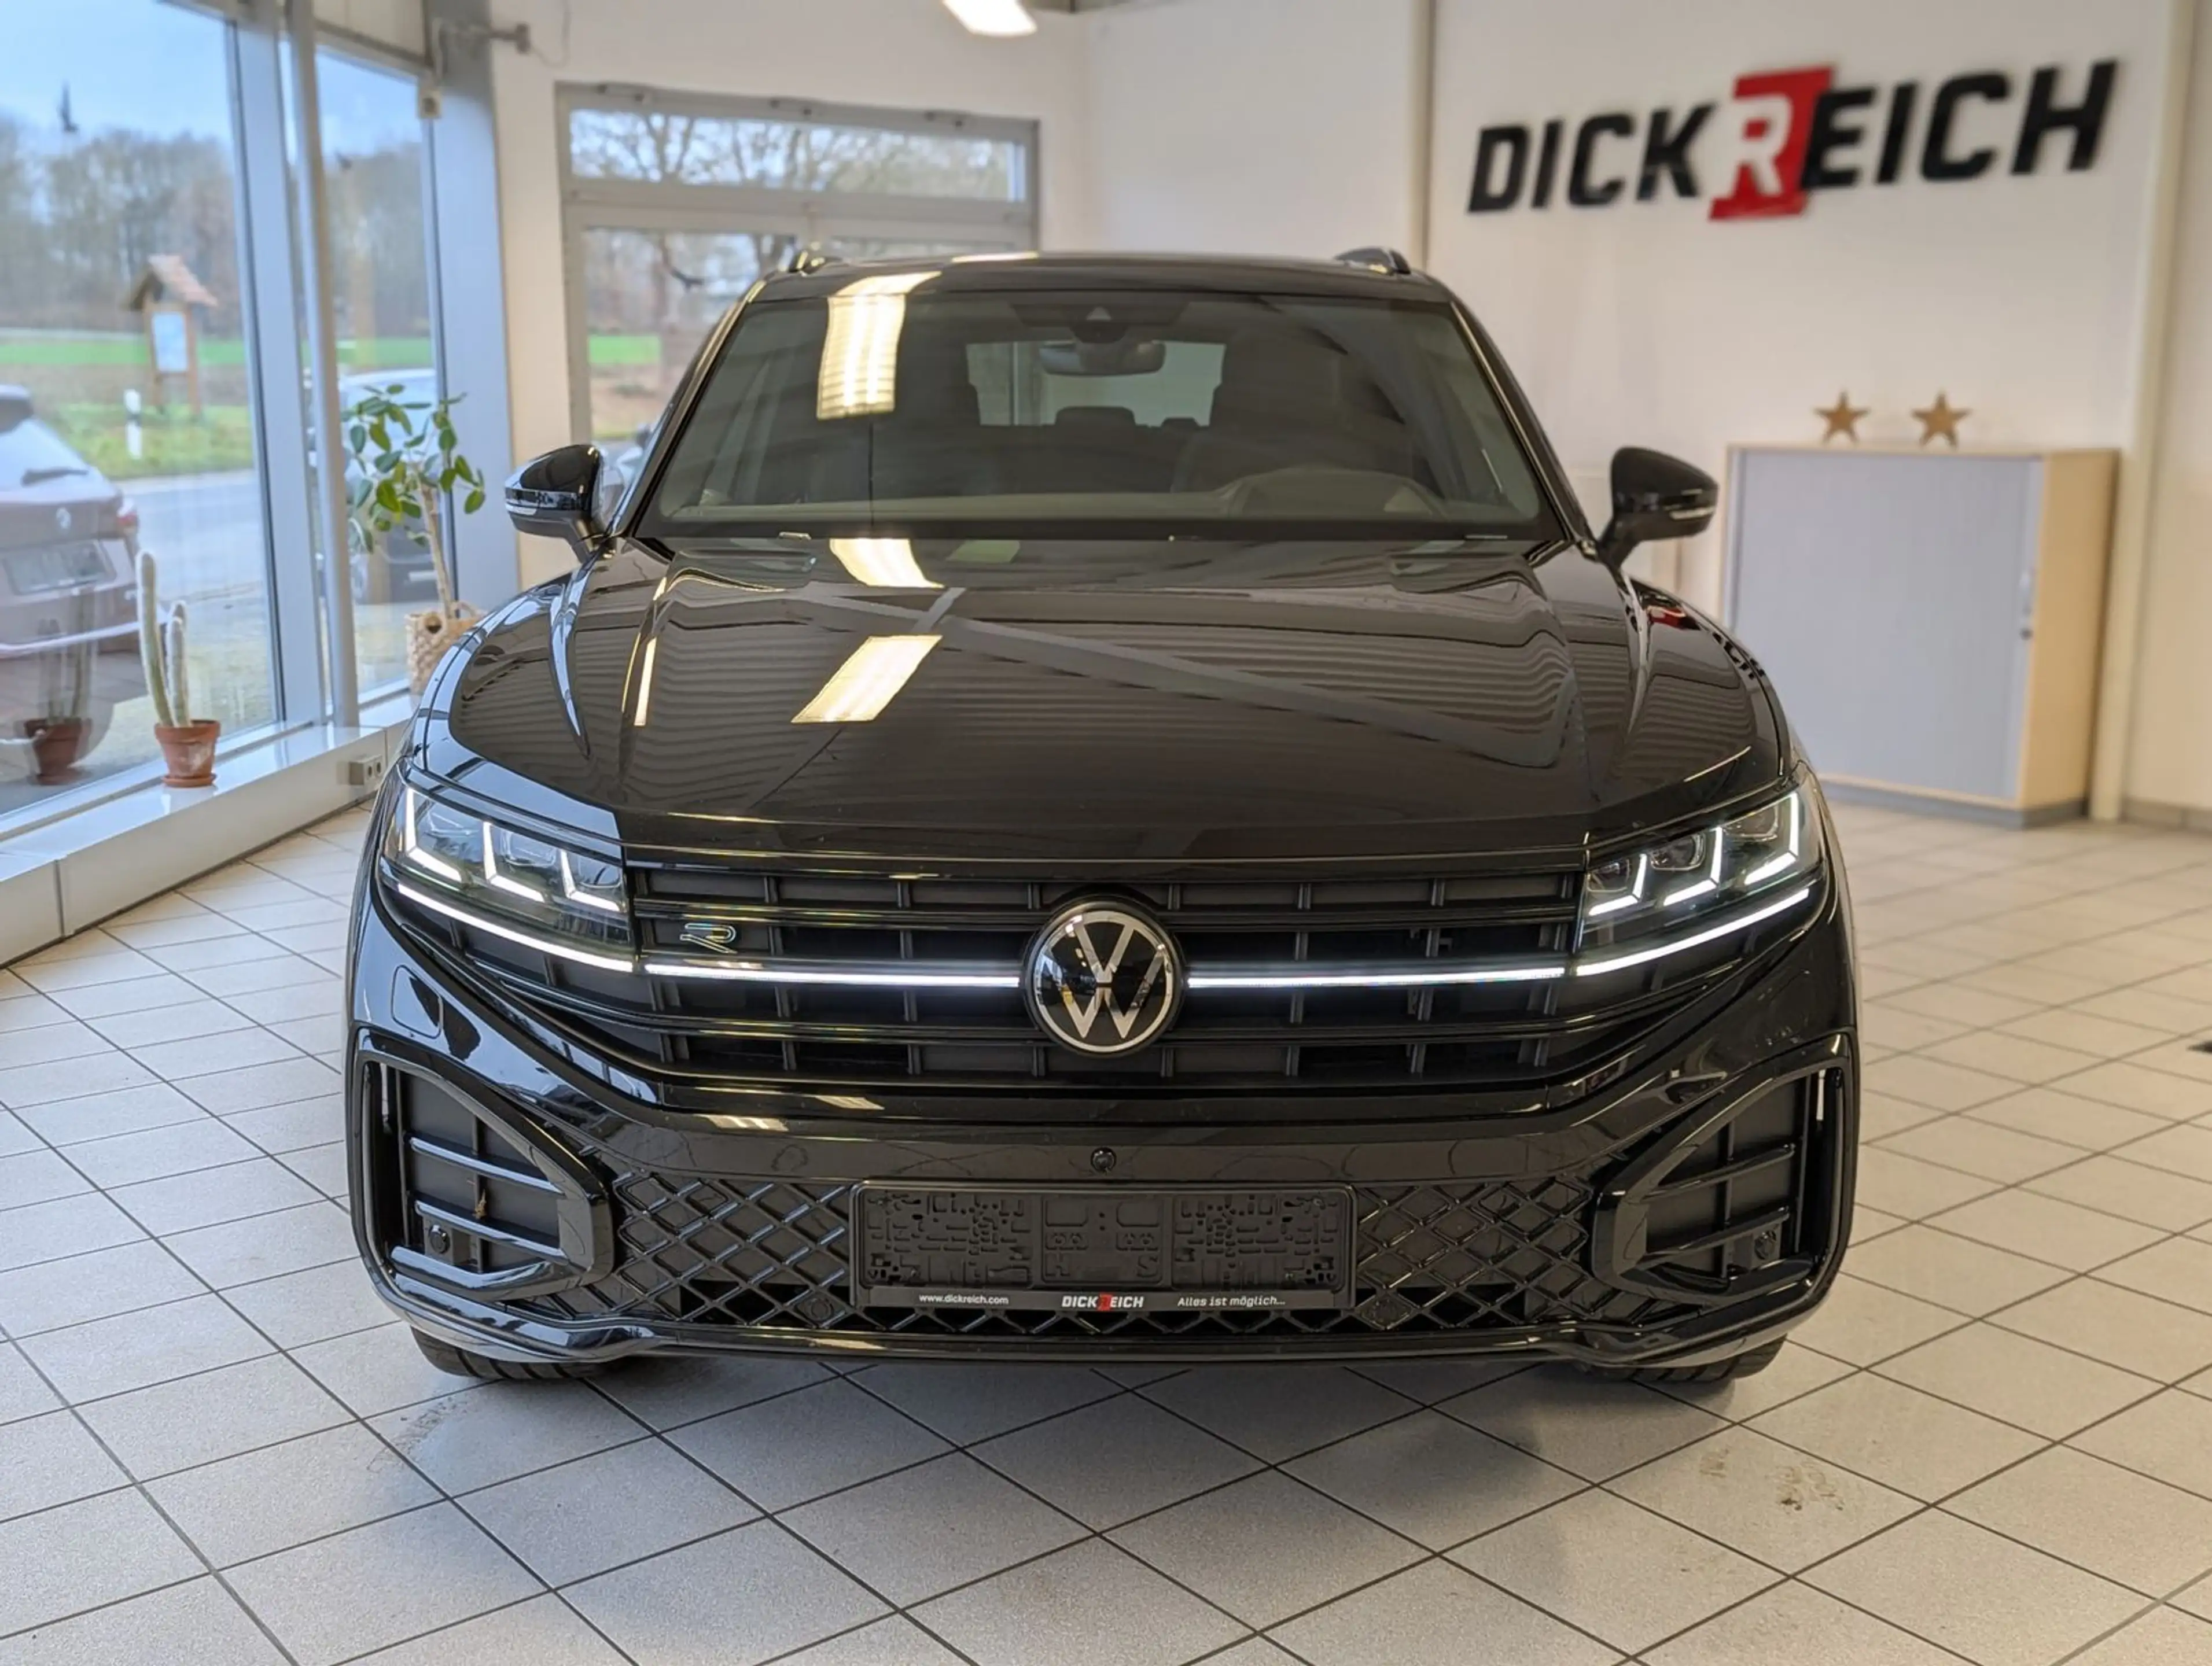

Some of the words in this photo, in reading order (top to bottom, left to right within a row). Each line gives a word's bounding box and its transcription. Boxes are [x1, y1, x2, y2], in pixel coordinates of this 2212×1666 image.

[1468, 59, 2118, 221] DICKREICH
[919, 1293, 1009, 1305] www.dickreich.com
[1177, 1296, 1207, 1307] Alles
[1209, 1296, 1227, 1306] ist
